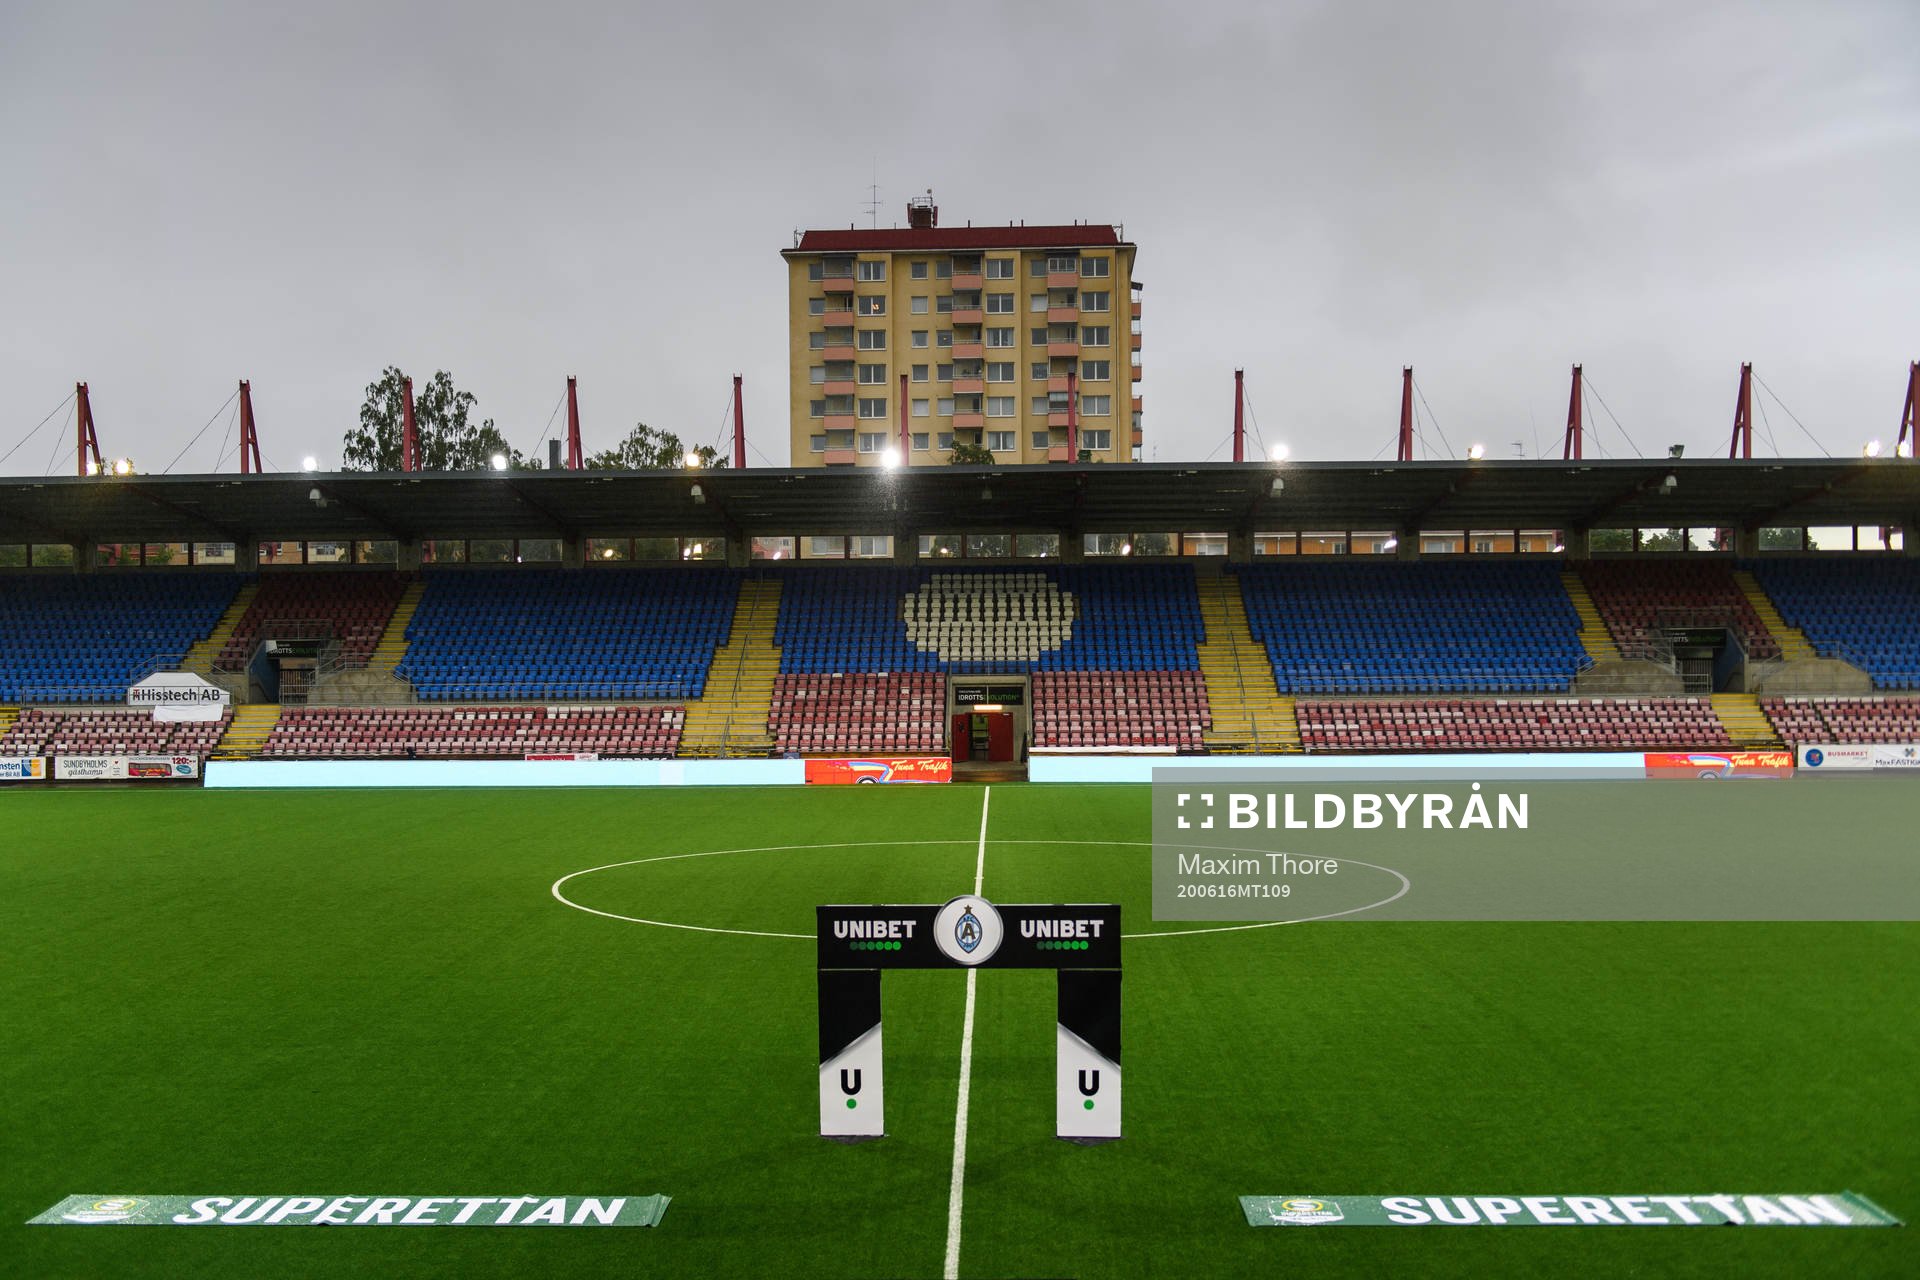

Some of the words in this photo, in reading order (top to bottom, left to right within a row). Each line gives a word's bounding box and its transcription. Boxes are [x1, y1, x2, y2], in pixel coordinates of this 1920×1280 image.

[141, 688, 197, 701] Hisstech
[201, 689, 220, 701] AB
[63, 759, 108, 768] SUNDBYHOLMS
[891, 759, 914, 771] Tuna
[917, 759, 948, 774] Trafik
[1731, 754, 1755, 766] Tuna
[1758, 753, 1789, 768] Trafik
[833, 920, 917, 939] UNIBET
[1020, 919, 1104, 938] UNIBET
[840, 1068, 862, 1096] U
[1078, 1069, 1100, 1097] U
[172, 1196, 627, 1225] SUPERETTAN
[1380, 1195, 1854, 1225] SUPERETTAN
